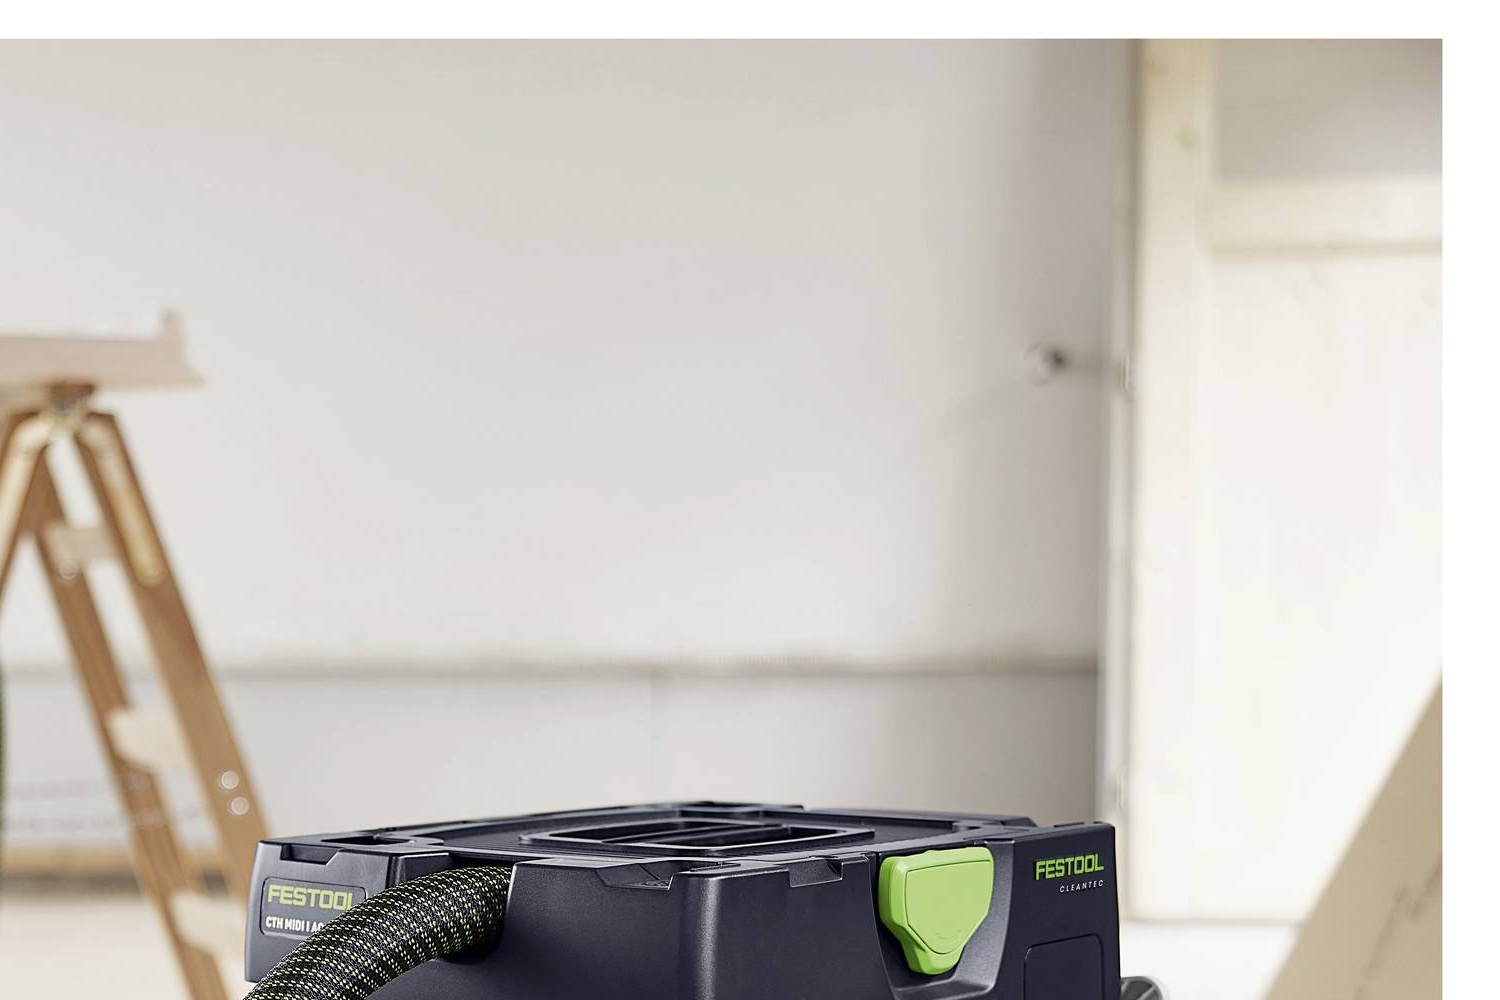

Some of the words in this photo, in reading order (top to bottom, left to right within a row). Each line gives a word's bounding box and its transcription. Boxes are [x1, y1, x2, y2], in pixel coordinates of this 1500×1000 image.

[1035, 853, 1105, 881] FESTOOL
[1059, 880, 1104, 893] CLEANTEC
[265, 916, 283, 929] CTH
[284, 918, 305, 932] MIDI
